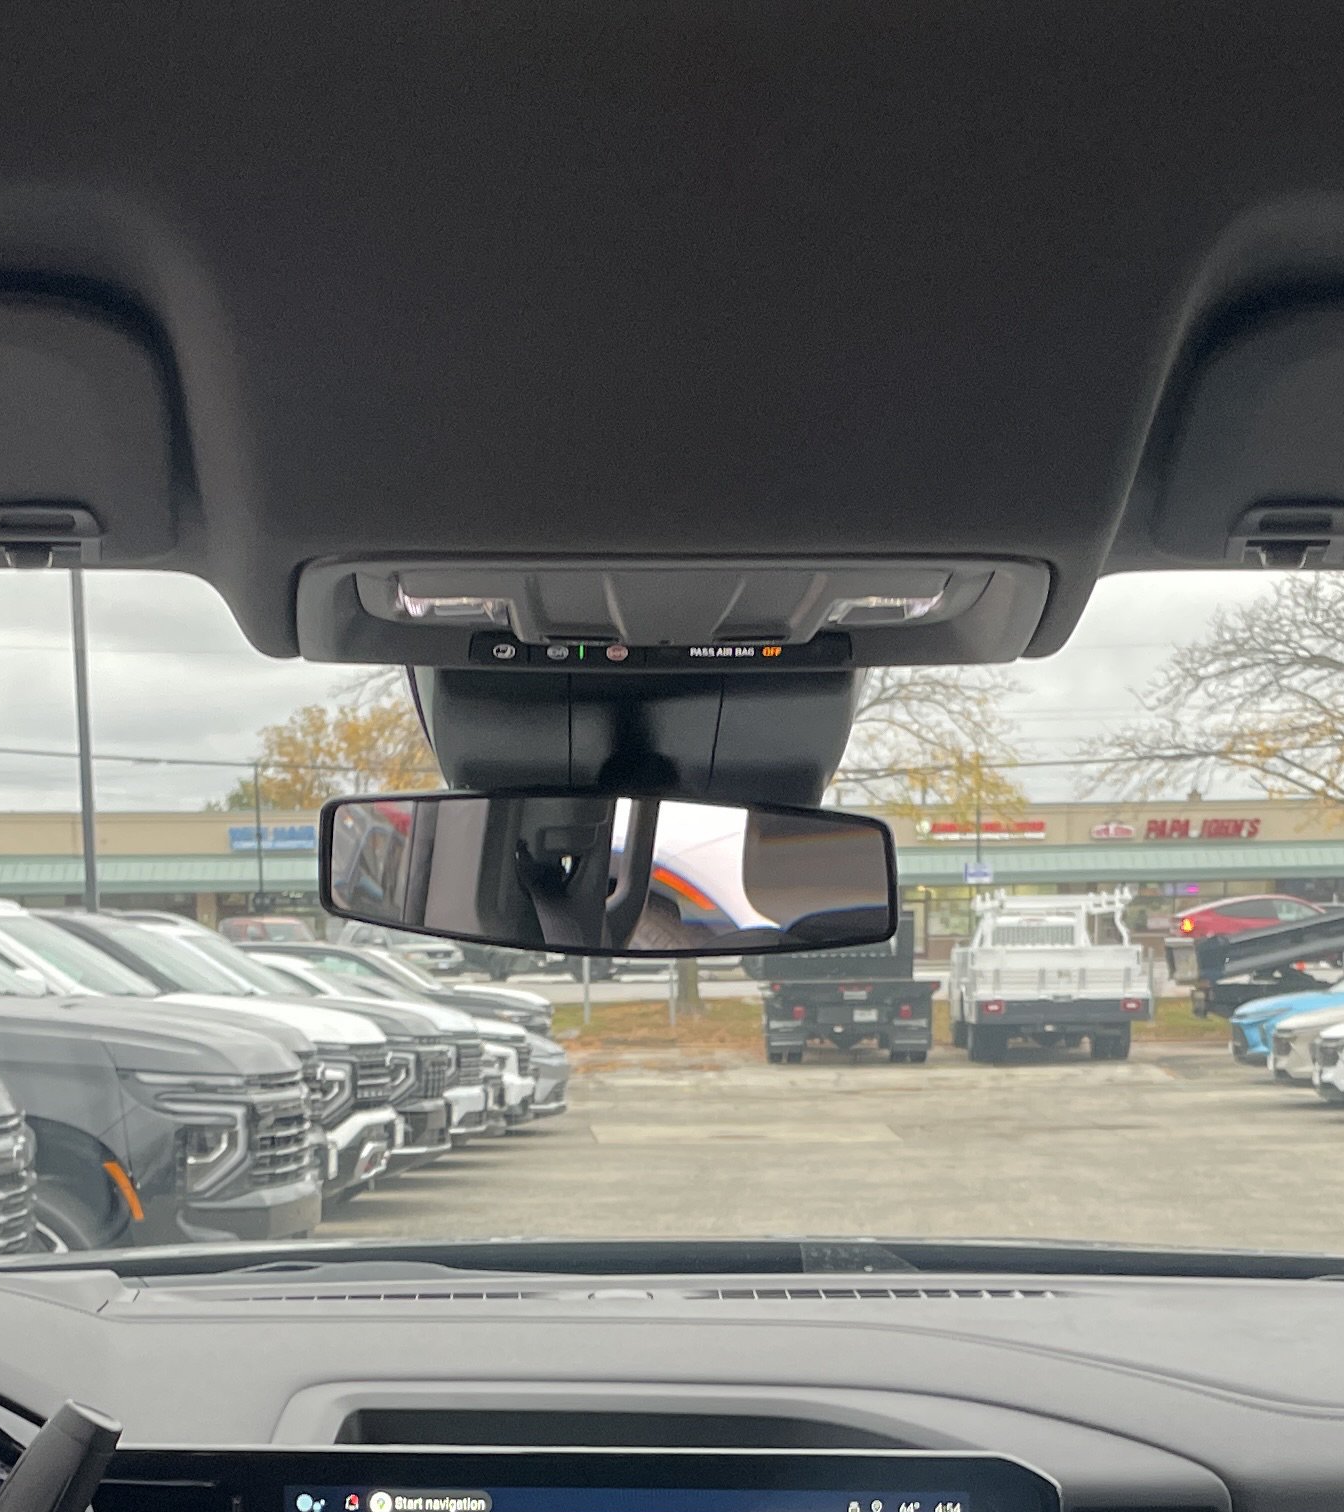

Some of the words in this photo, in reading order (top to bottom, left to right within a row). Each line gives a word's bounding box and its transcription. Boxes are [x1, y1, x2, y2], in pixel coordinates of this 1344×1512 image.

[689, 647, 715, 657] PASS
[716, 647, 733, 657] AIR
[734, 647, 755, 657] BAG
[762, 646, 782, 657] OFF
[1145, 818, 1190, 839] PAPA
[1200, 817, 1261, 839] JOHN'S
[394, 1496, 423, 1510] Start
[425, 1497, 486, 1512] navigation
